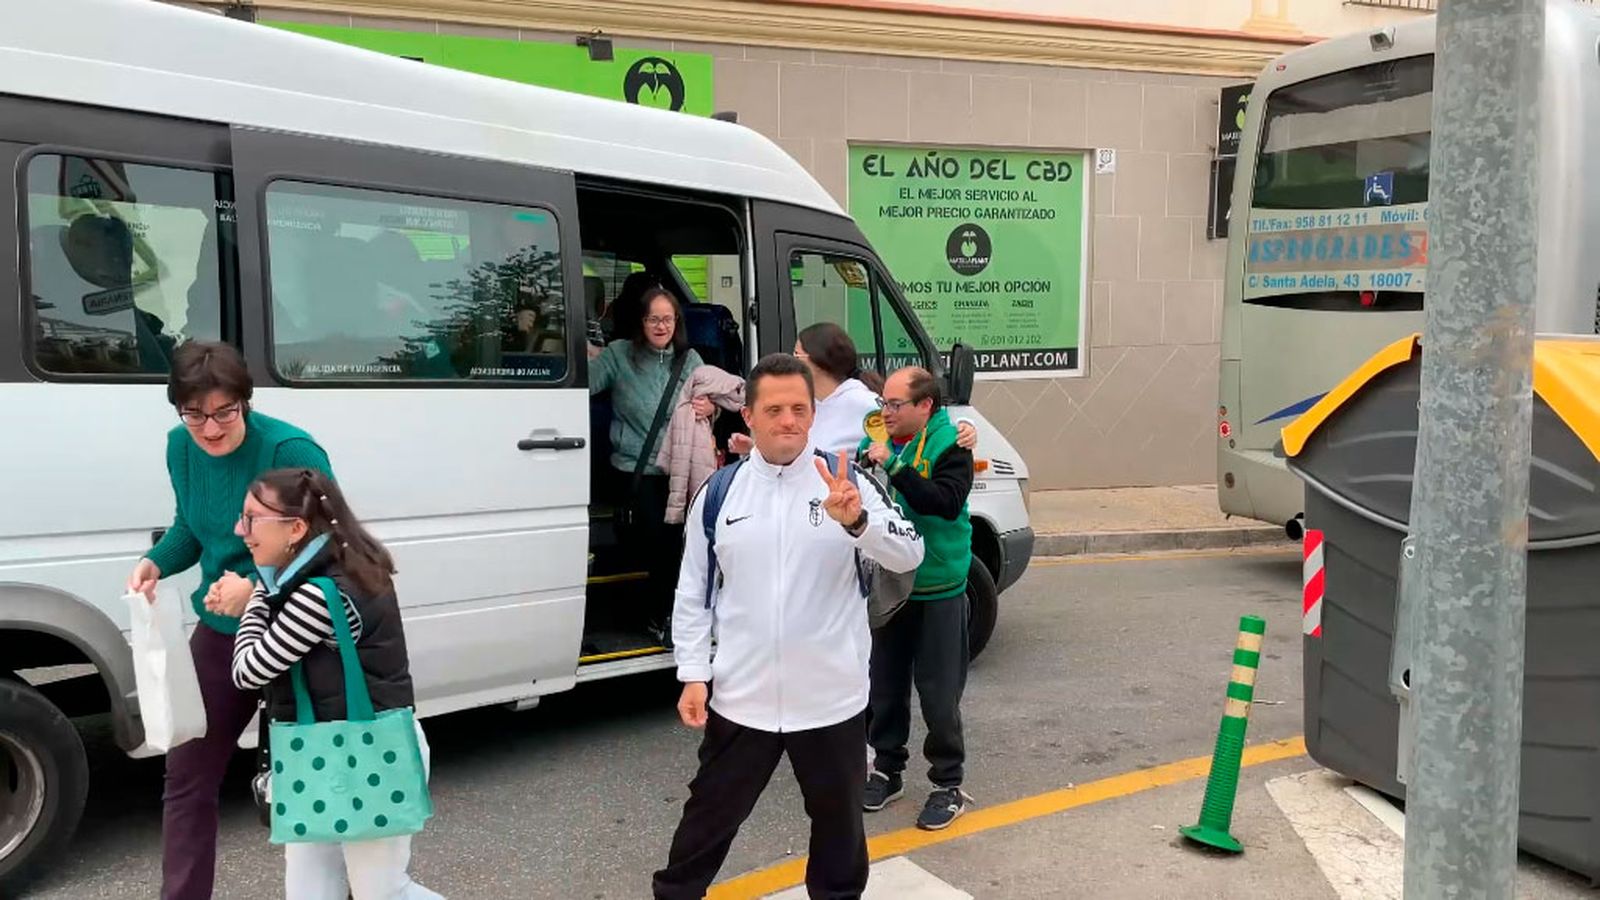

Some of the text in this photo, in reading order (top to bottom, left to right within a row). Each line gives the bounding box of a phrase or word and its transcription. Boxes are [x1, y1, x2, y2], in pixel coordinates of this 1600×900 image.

[863, 151, 1072, 182] EL AÑO DEL CBD
[900, 187, 1037, 202] EL MEJOR SERVICIO AL
[879, 205, 1056, 220] MEJOR PRECIO GARANTIZADO
[1295, 216, 1315, 228] 958
[1318, 215, 1332, 227] 81
[1337, 214, 1350, 225] 12
[1355, 212, 1368, 224] 11
[1380, 208, 1419, 222] Móvil:
[936, 281, 952, 293] TU
[956, 281, 999, 293] MEJOR
[1004, 279, 1051, 293] OPCIÓN
[1263, 275, 1296, 288] Santa
[1300, 274, 1338, 289] Adela,
[1344, 275, 1359, 287] 43
[1369, 273, 1413, 287] 18007
